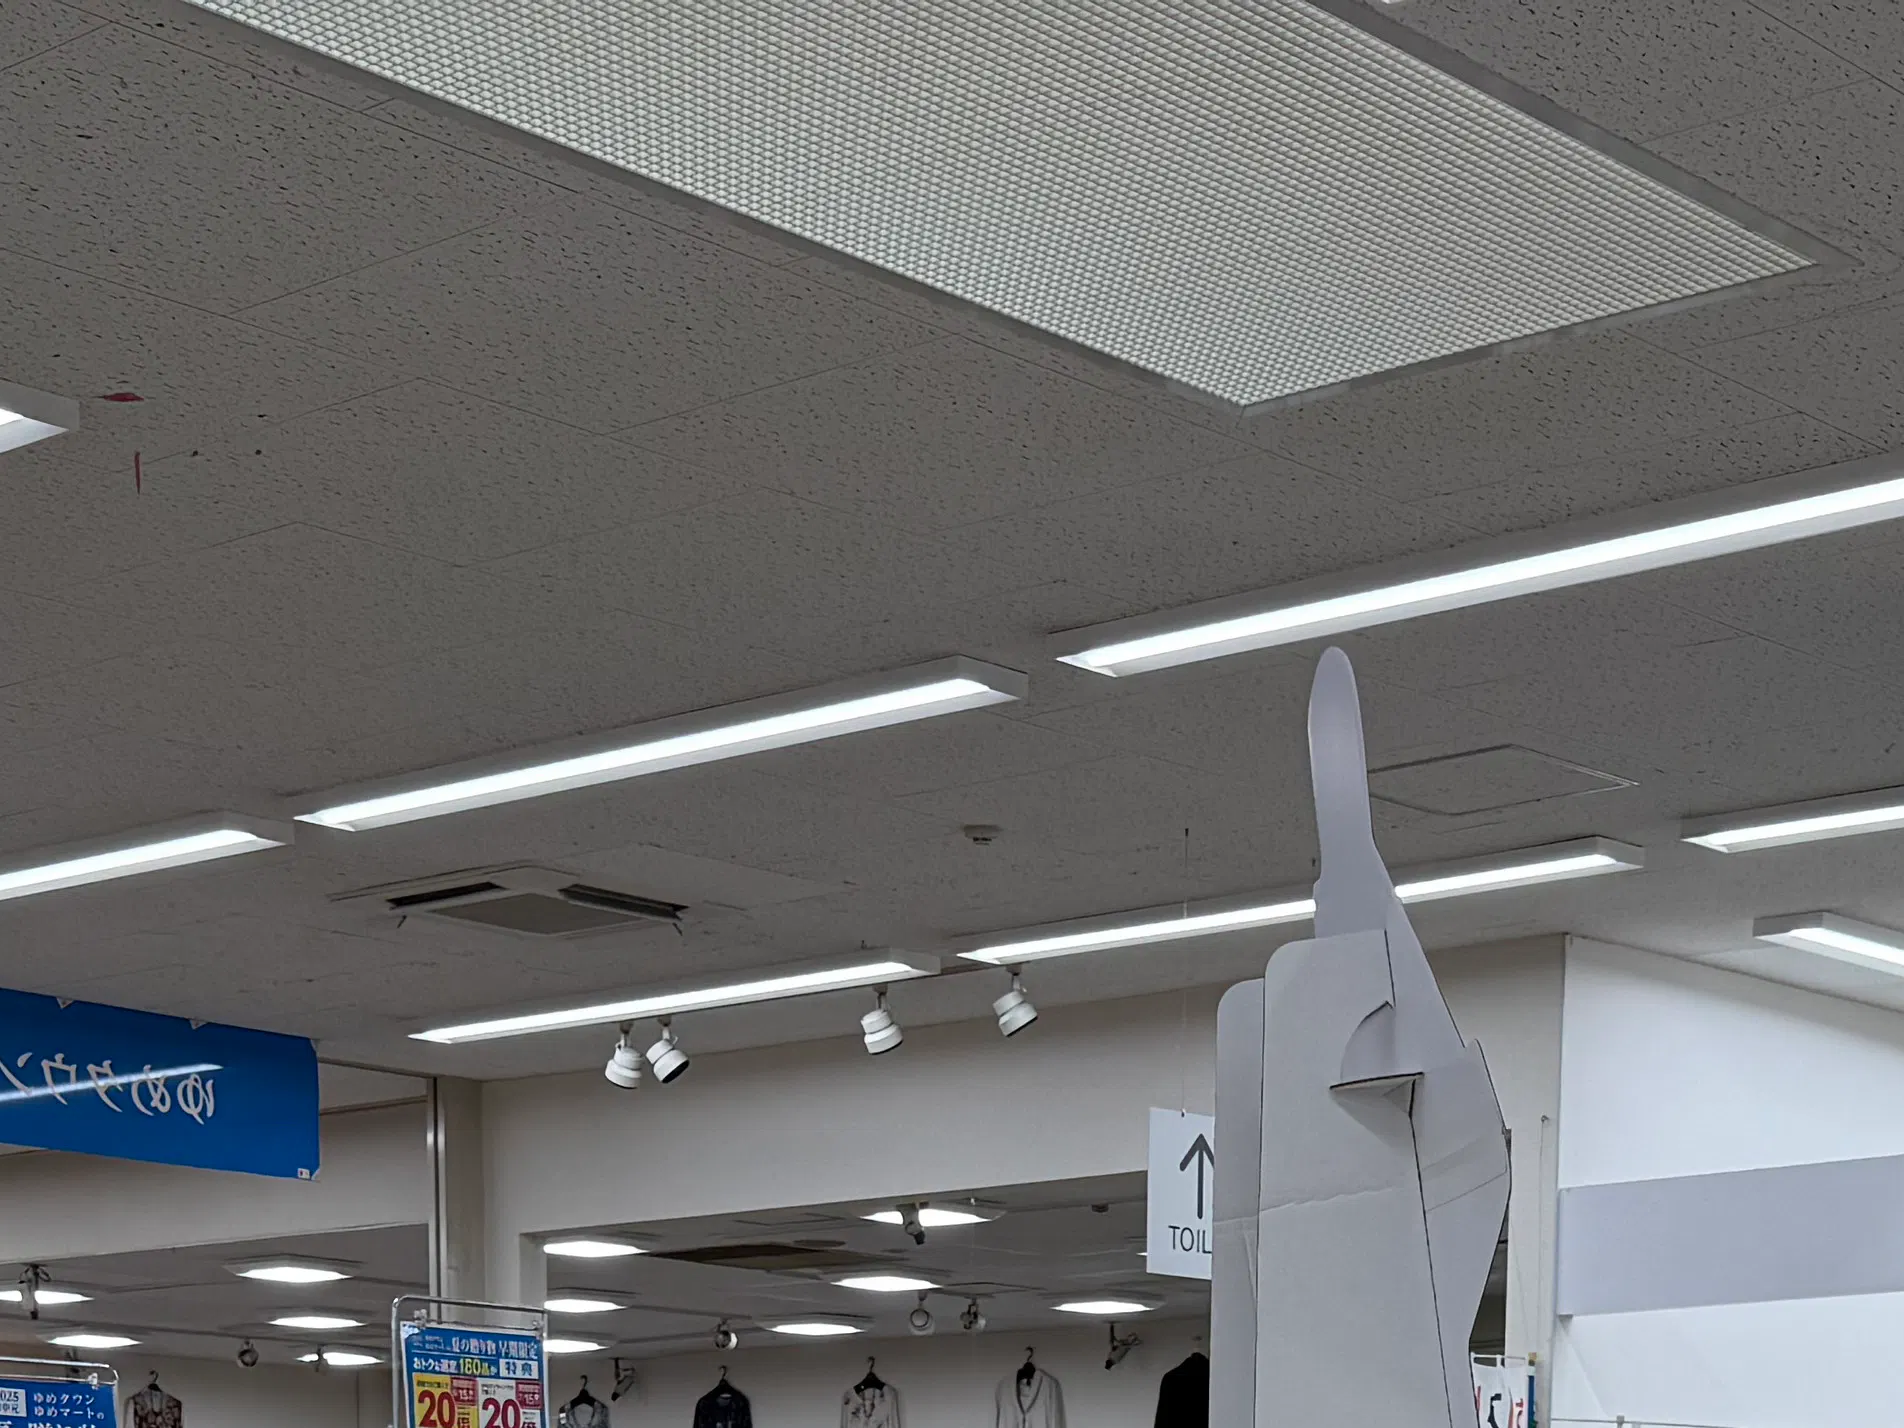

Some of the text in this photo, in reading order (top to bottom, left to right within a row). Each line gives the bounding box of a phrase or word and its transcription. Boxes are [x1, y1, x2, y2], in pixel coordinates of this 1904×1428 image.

[33, 1392, 95, 1406] ゆめタウン
